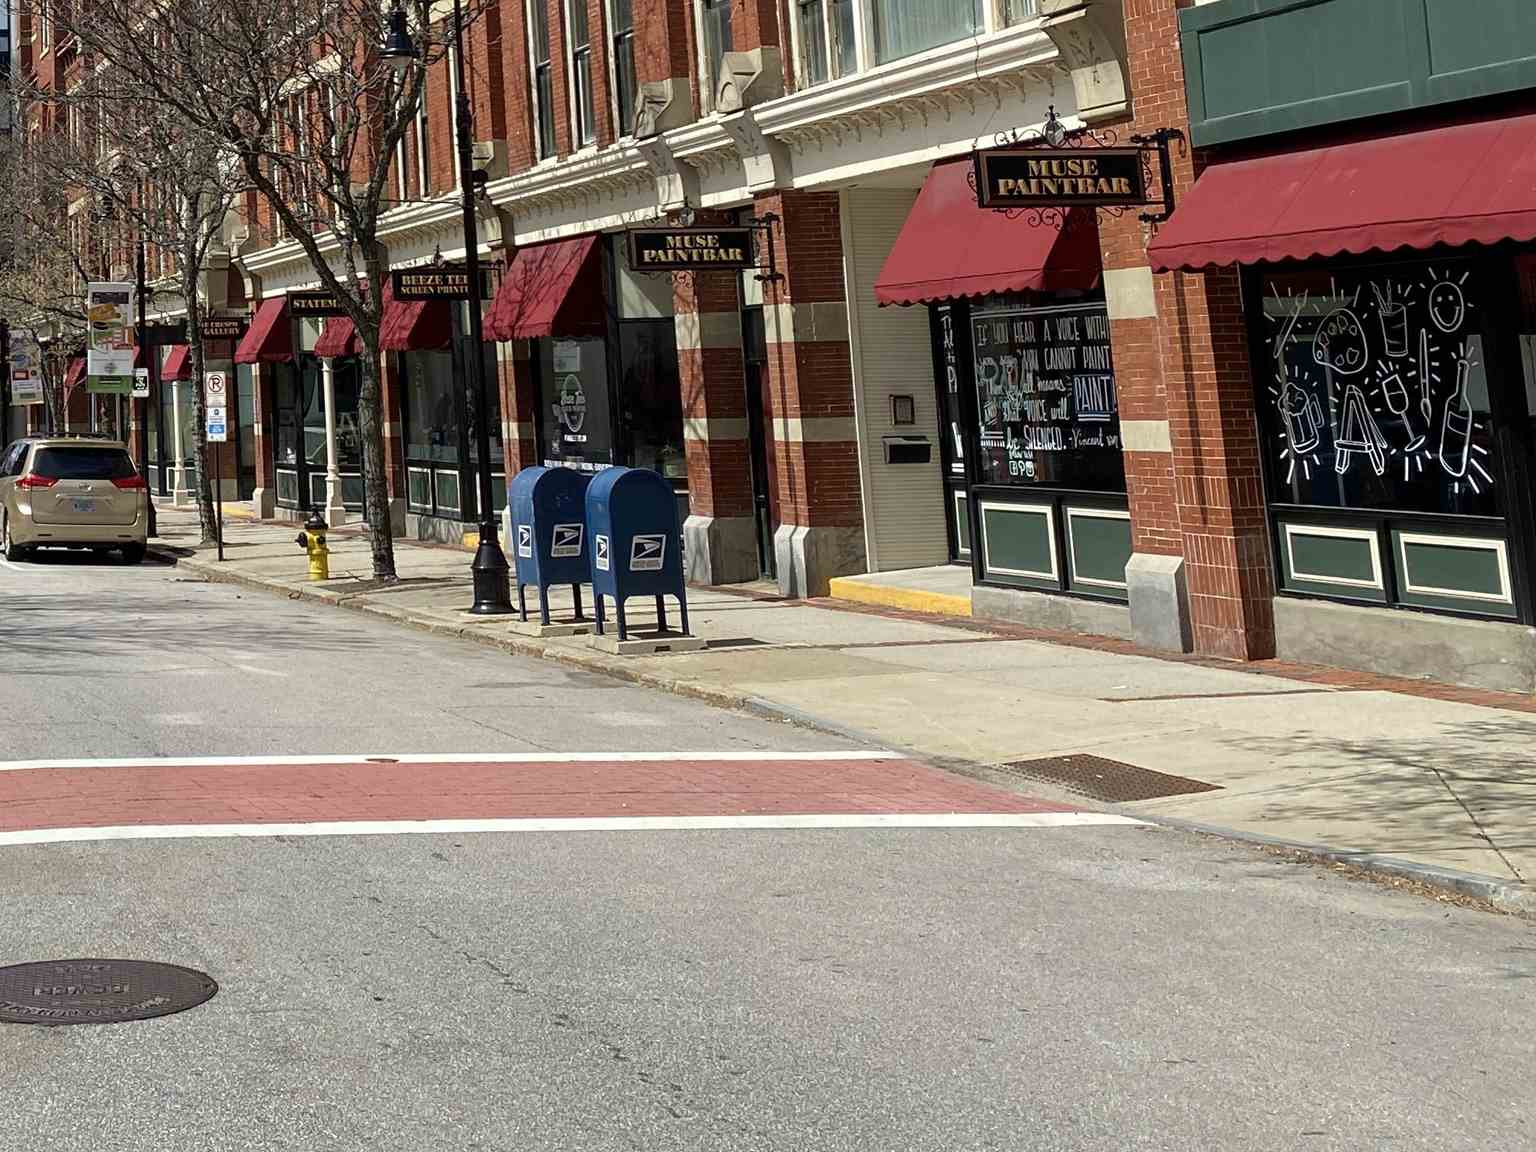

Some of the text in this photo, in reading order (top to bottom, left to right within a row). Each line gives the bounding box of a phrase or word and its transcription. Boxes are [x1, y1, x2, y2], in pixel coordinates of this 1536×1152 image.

[1027, 159, 1099, 177] MUSE
[998, 178, 1131, 195] PAINTBAR
[665, 235, 720, 248] MUSE
[643, 248, 744, 262] PAINTBAR
[204, 327, 240, 336] GALLERY
[1043, 319, 1051, 341] A
[1056, 316, 1081, 341] VOICE
[1044, 346, 1076, 370] CANNOT
[1083, 345, 1110, 370] PAINT
[1073, 376, 1112, 412] PAINT
